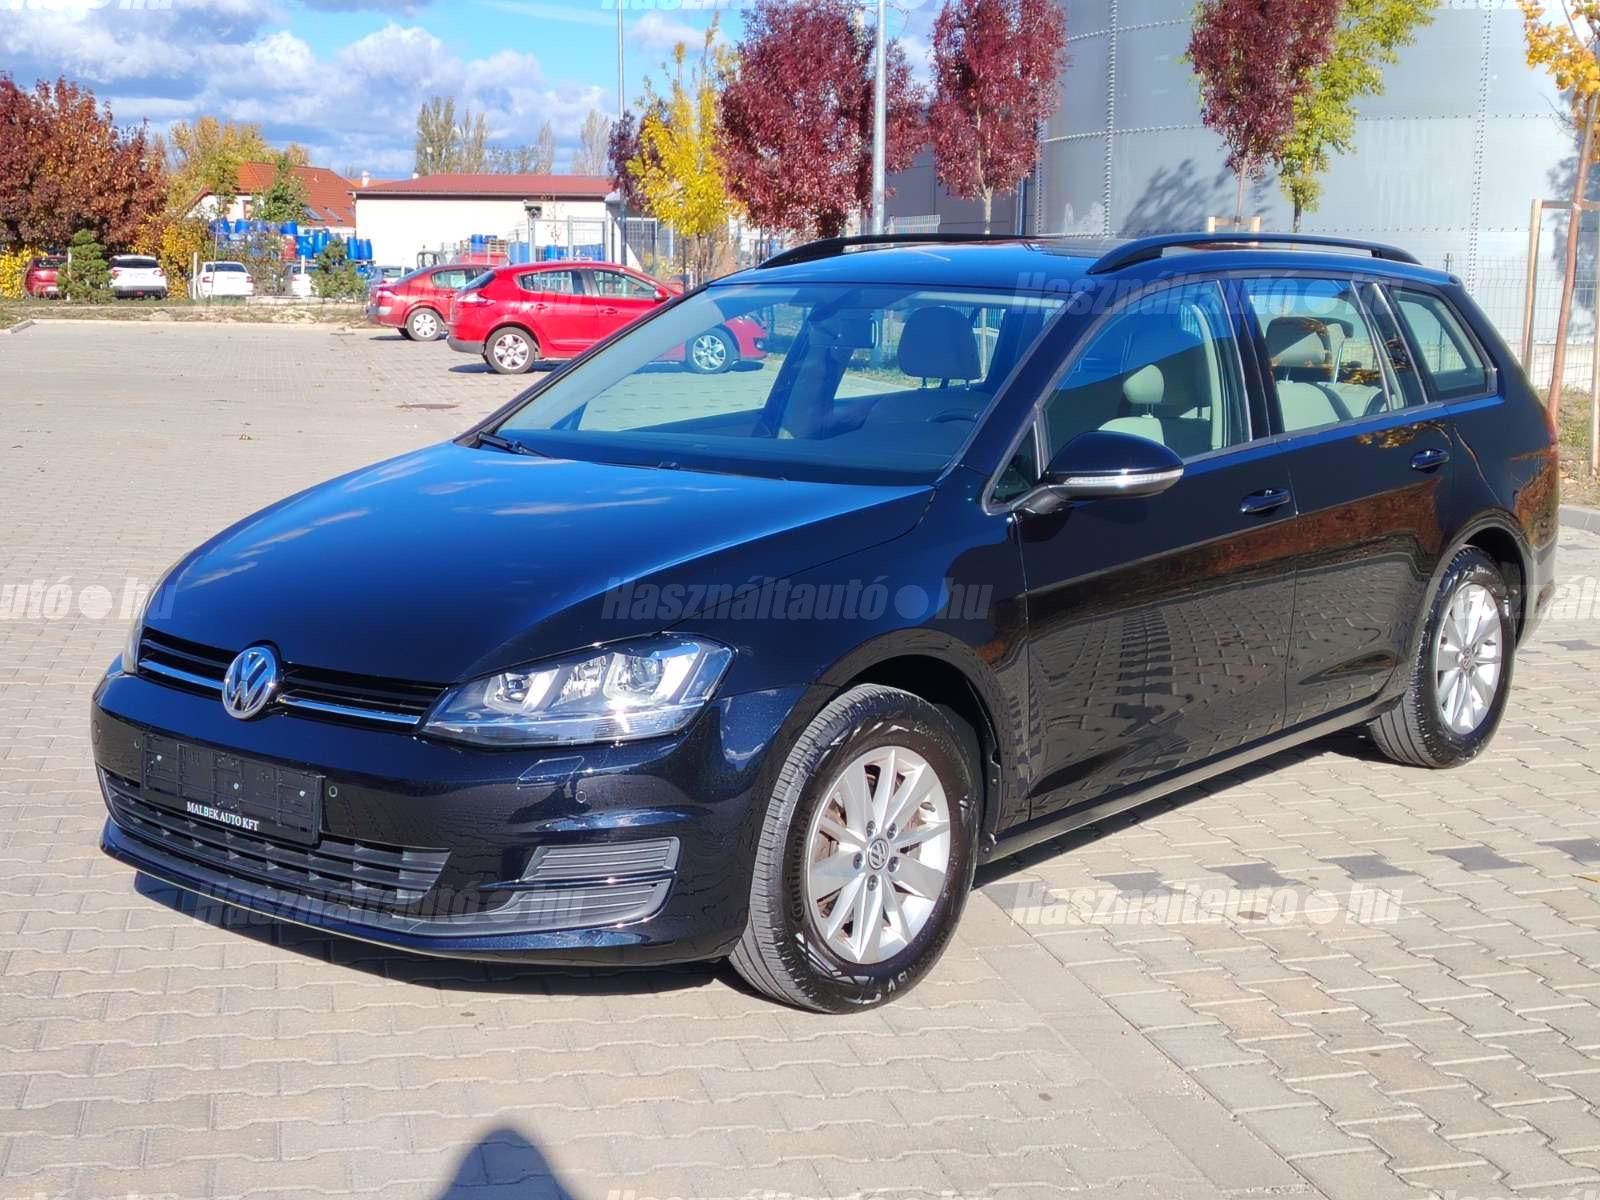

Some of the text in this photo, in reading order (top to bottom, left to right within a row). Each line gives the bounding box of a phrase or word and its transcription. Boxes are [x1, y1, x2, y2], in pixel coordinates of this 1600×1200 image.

[186, 801, 260, 832] MALBEK AUTO KFT
